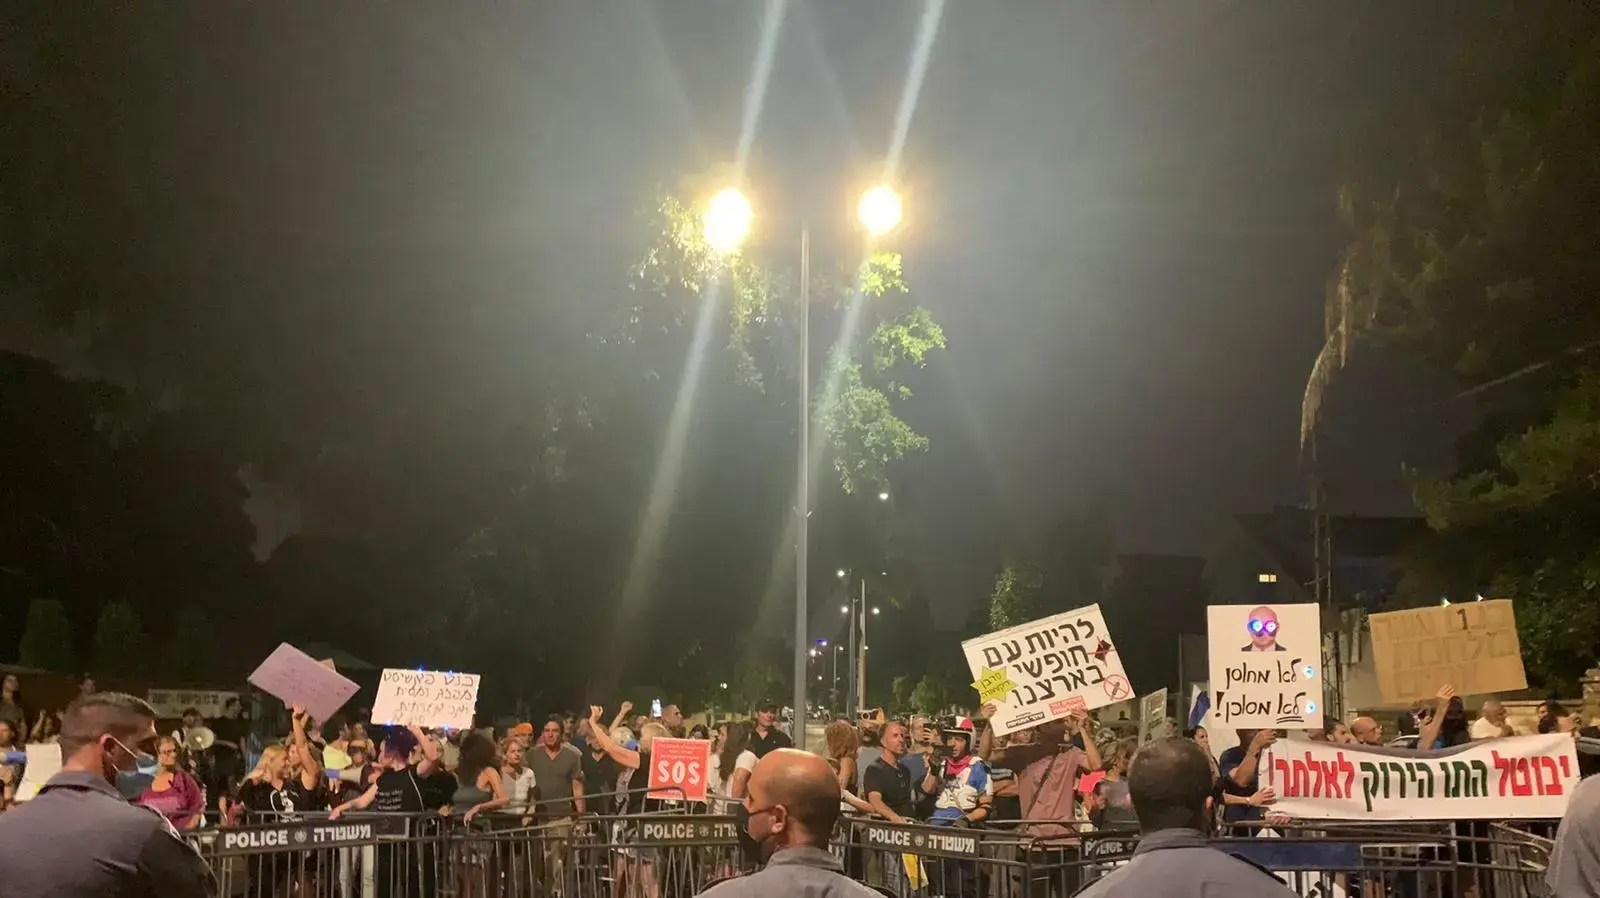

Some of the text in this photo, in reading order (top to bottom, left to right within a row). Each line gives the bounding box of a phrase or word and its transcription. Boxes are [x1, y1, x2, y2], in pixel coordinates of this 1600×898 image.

[982, 618, 1095, 667] להיות עם
[1012, 645, 1090, 678] חופשי
[383, 672, 474, 688] בנט פאשיסט
[981, 672, 1002, 689] סרבן
[1226, 658, 1302, 689] לא מחוסן
[1012, 665, 1105, 709] בארצנו.
[449, 704, 468, 719] ואני
[1214, 691, 1307, 723] לא מסוכן!
[658, 760, 700, 785] SOS
[1268, 750, 1572, 812] יבוטל התו הירוק לאלתר!
[225, 829, 288, 848] POLICE
[313, 824, 371, 843] משטרה
[644, 823, 694, 839] POLICE
[869, 828, 911, 846] POLICE
[928, 834, 975, 853] משטרה
